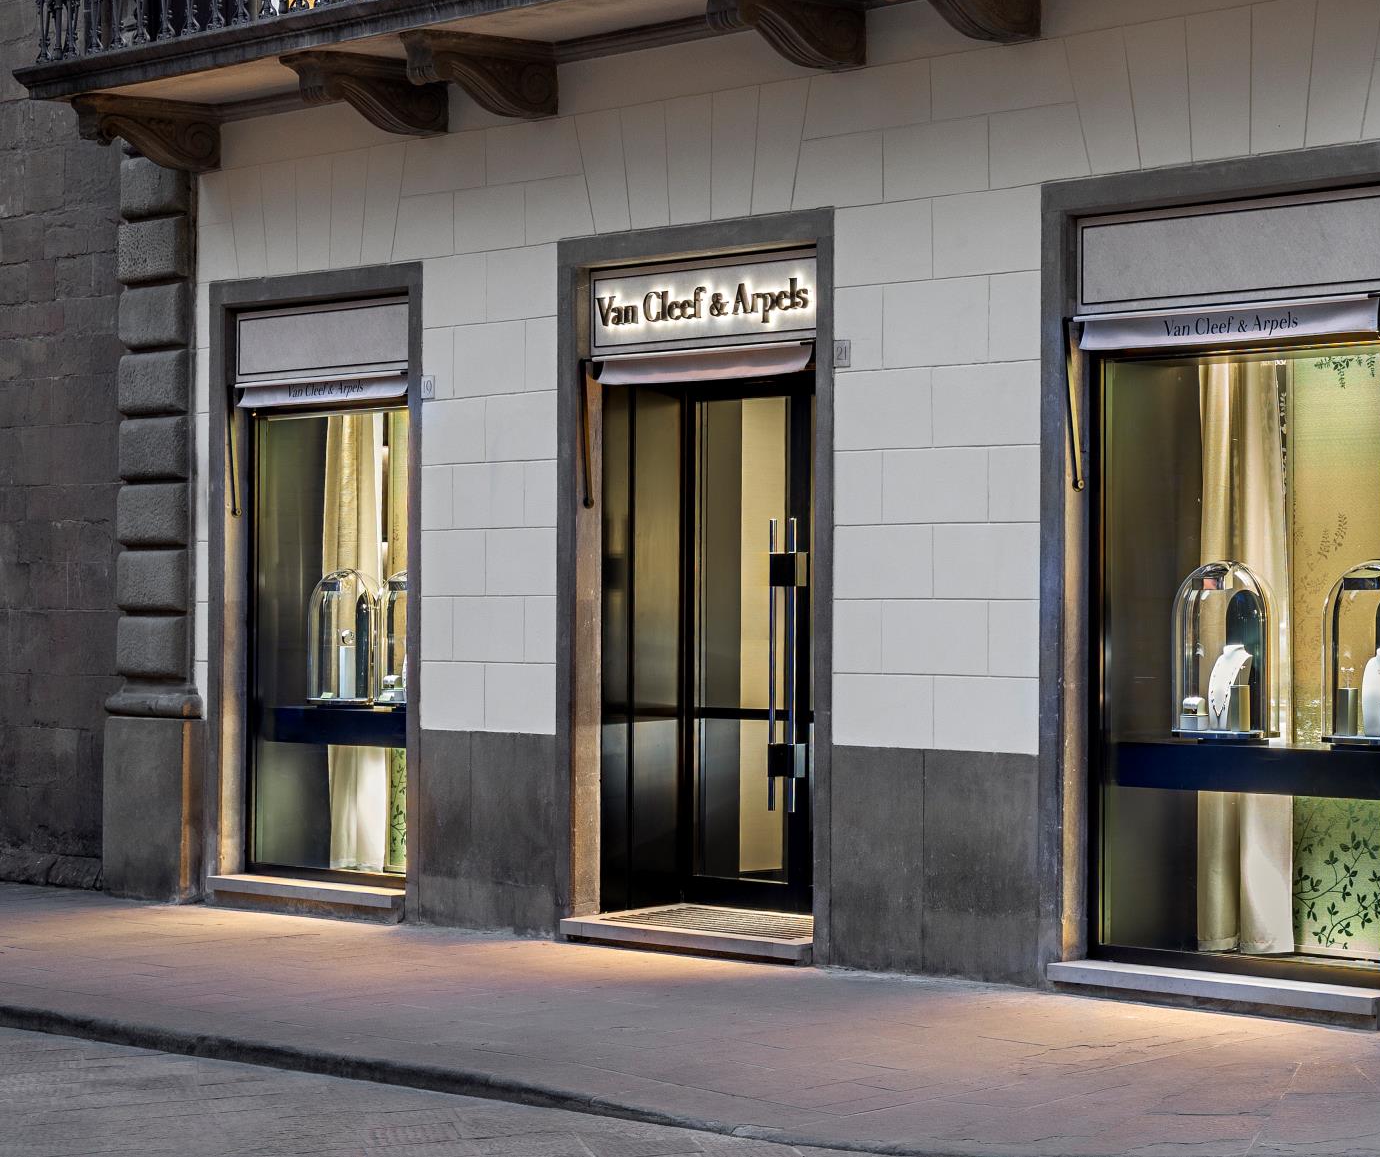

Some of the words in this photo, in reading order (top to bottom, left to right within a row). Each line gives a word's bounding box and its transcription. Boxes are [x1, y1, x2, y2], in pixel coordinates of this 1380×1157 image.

[596, 295, 639, 327] Van
[642, 285, 707, 323] Cleef
[709, 292, 730, 318] &
[732, 277, 809, 324] Arpels
[1164, 319, 1190, 337] Van
[1194, 315, 1234, 335] Cleef
[1237, 319, 1248, 333] &
[1251, 311, 1299, 336] Arpels
[836, 345, 847, 361] 21
[288, 383, 304, 398] Van
[305, 381, 328, 397] Cleef
[327, 384, 334, 395] &
[336, 379, 364, 398] Arpels
